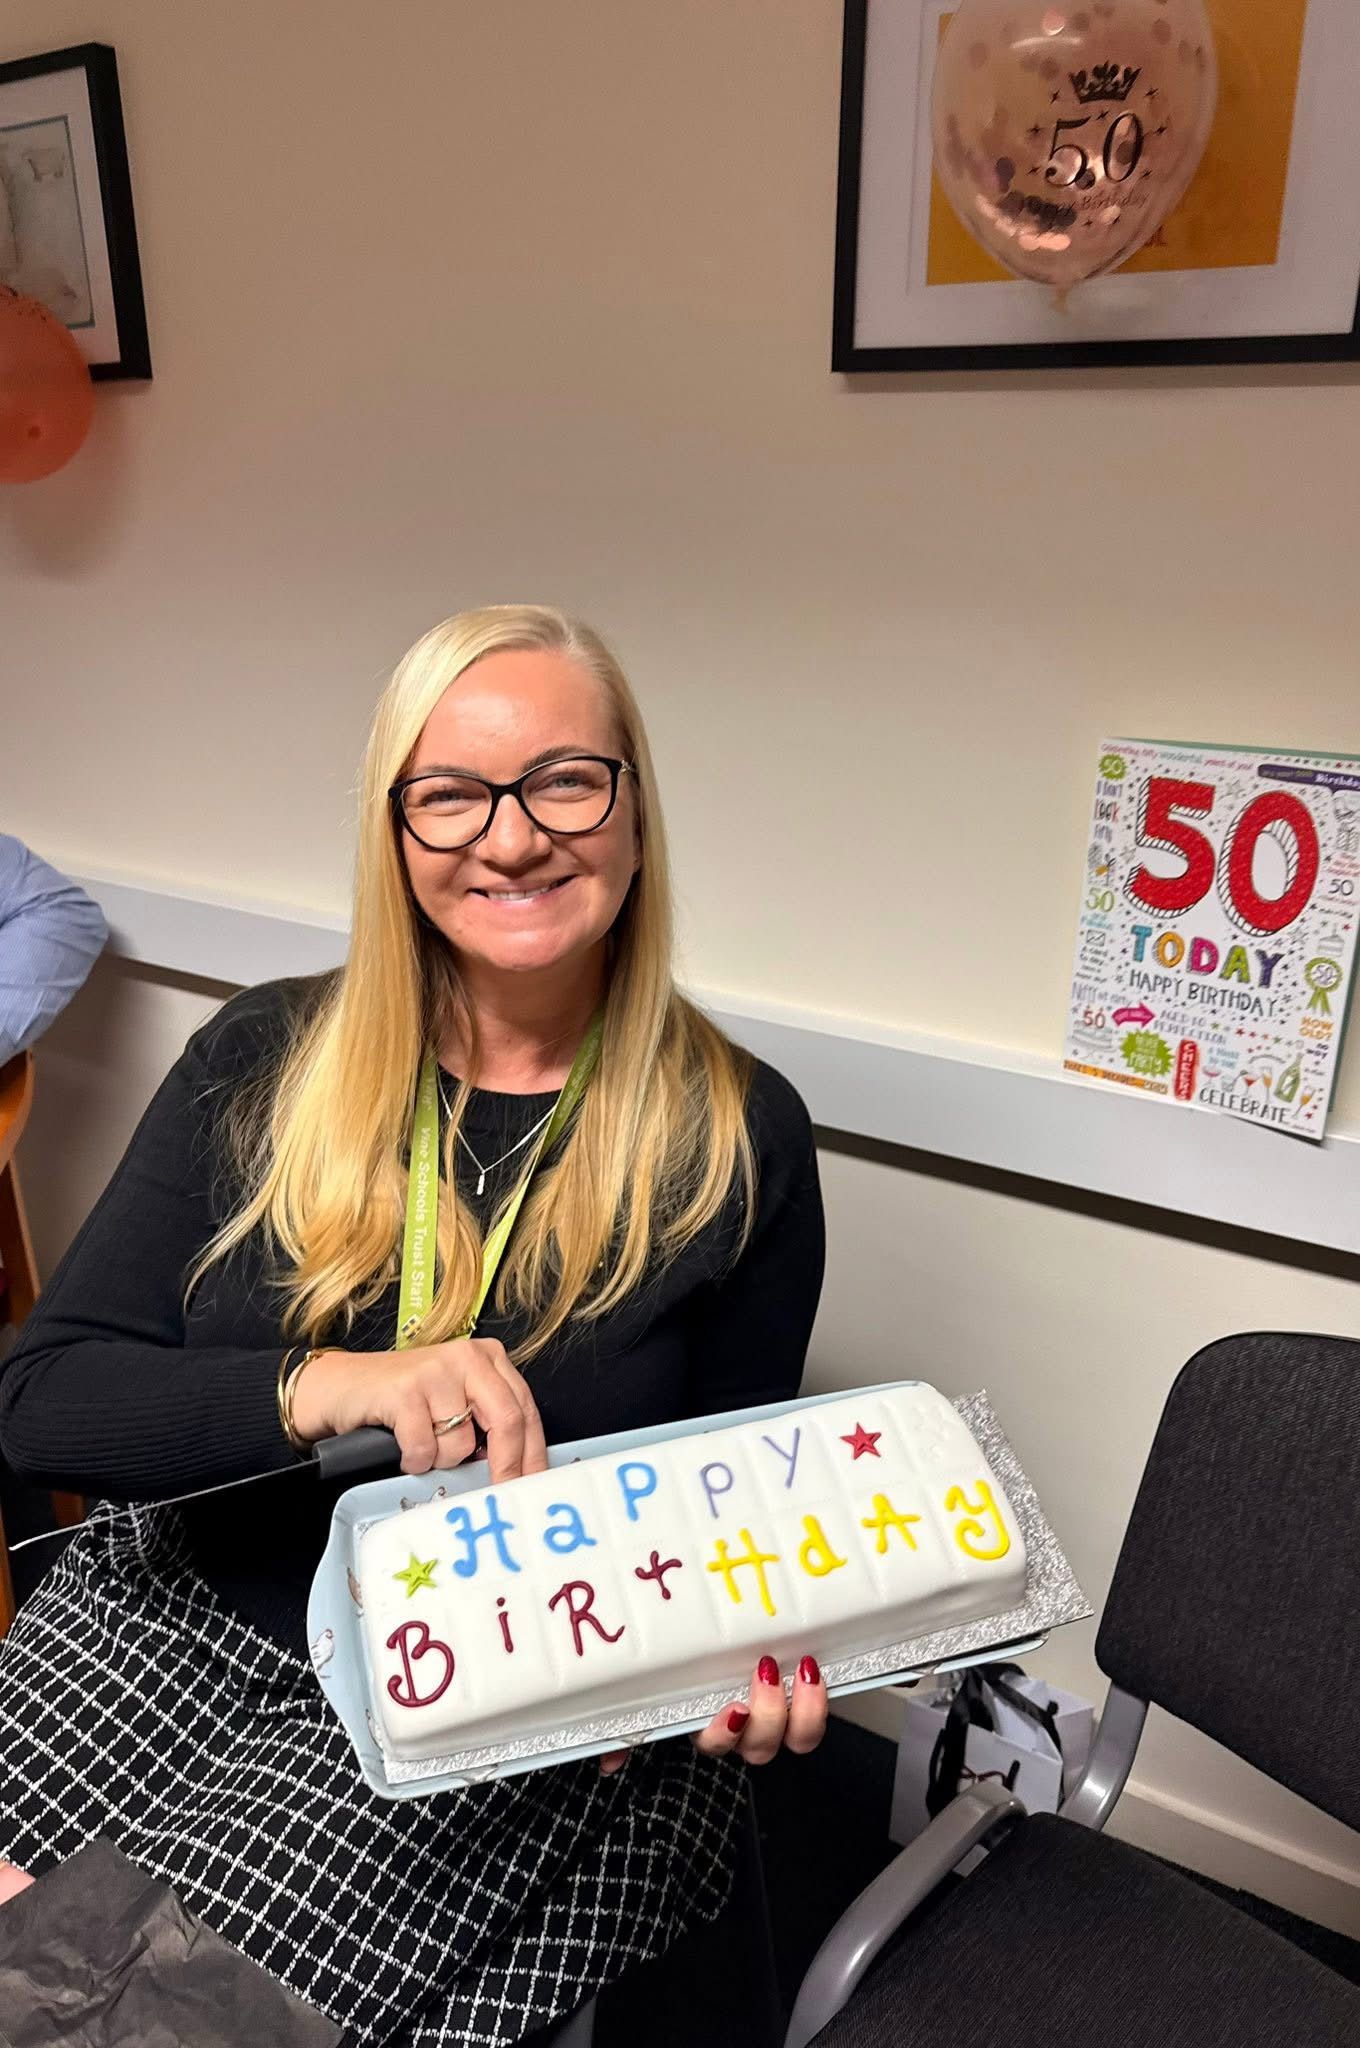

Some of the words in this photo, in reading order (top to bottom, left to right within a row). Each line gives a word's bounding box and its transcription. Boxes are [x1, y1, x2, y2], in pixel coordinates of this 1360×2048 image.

[1045, 112, 1144, 186] 50
[1123, 775, 1319, 937] 50
[1086, 887, 1114, 912] 50
[1328, 879, 1354, 896] 50
[1130, 924, 1285, 988] TODAY
[1129, 969, 1183, 997] HAPPY
[1188, 982, 1277, 1017] BIRTHDAY
[1083, 1008, 1106, 1028] 50
[1301, 1015, 1334, 1030] HOW
[1199, 1087, 1291, 1125] CELEBRATE
[415, 1161, 430, 1222] Schools
[413, 1226, 428, 1267] Trust
[409, 1269, 425, 1309] Staff
[446, 1426, 801, 1580] Happy
